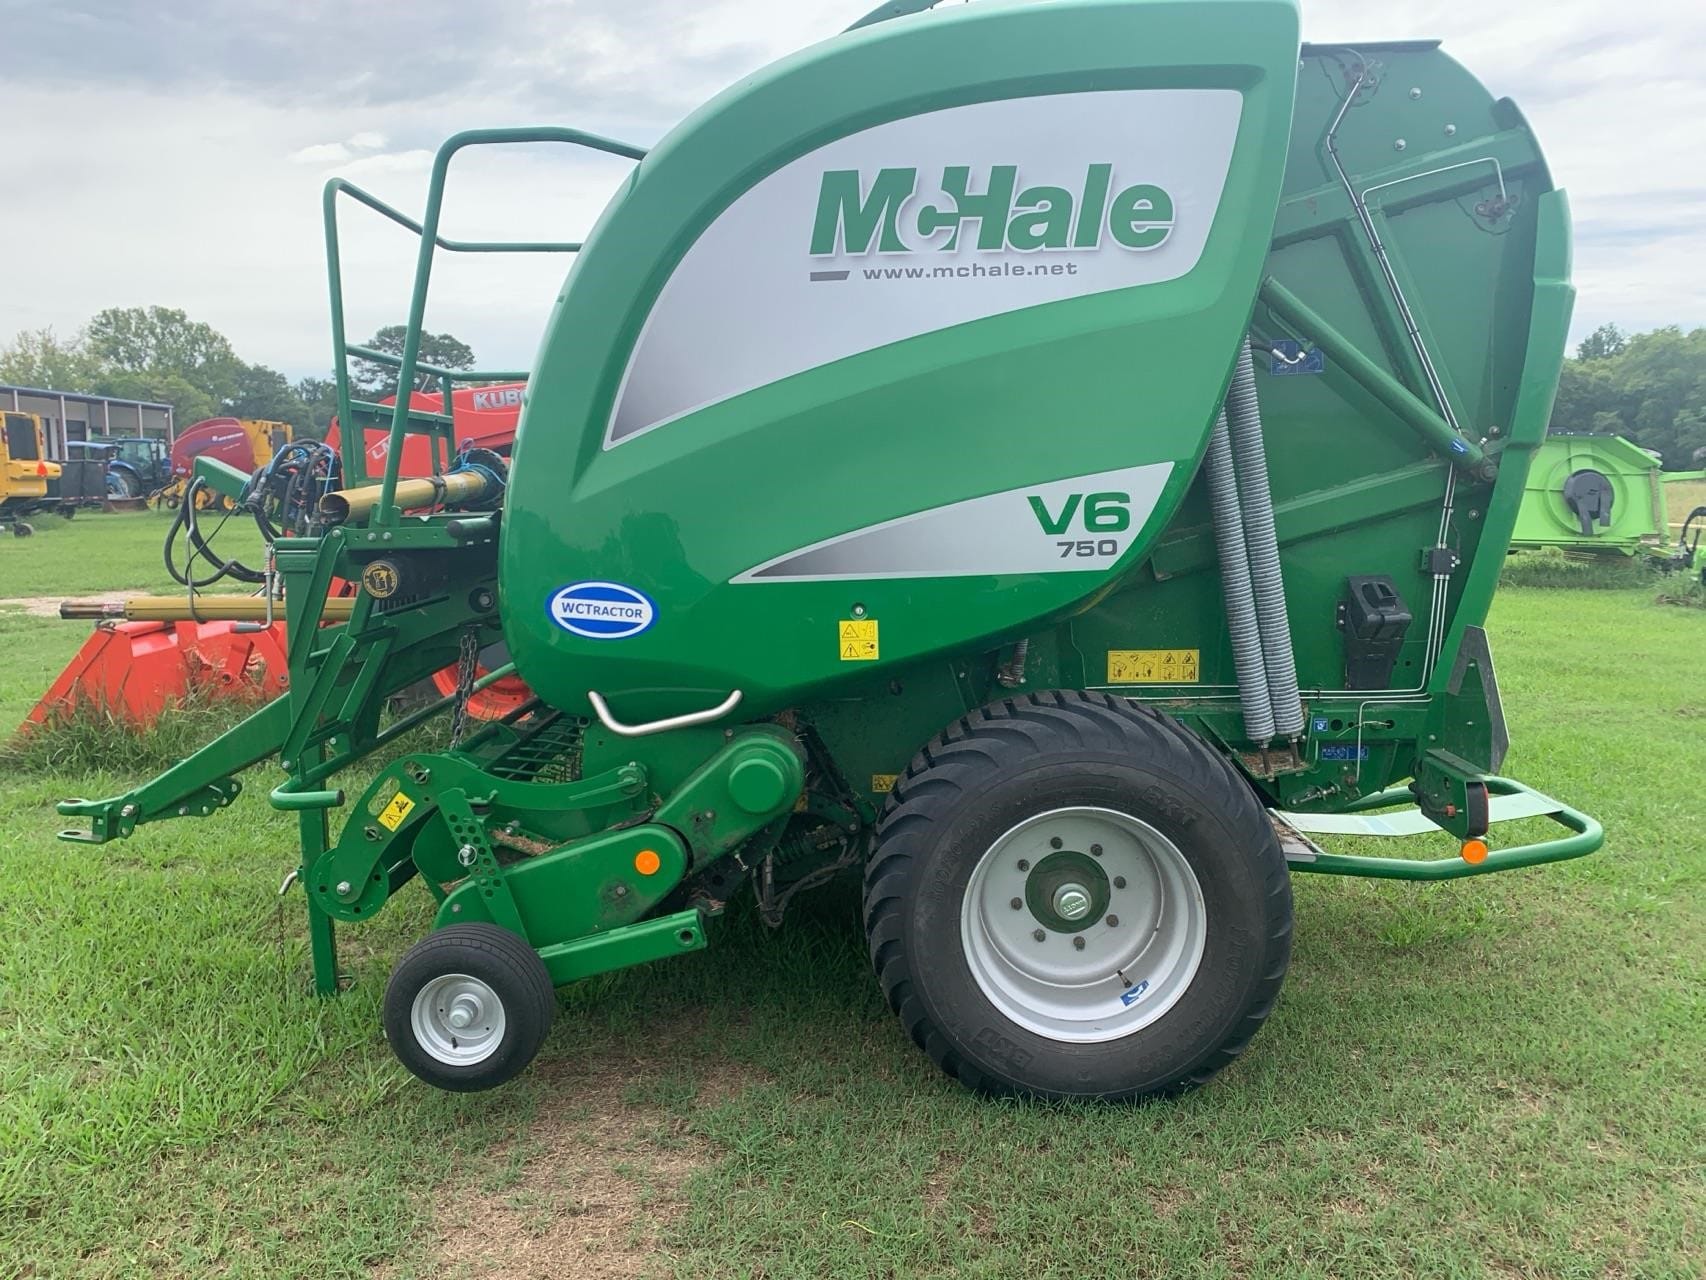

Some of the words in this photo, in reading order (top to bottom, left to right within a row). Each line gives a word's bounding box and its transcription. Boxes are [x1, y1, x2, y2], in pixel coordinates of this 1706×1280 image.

[808, 162, 1175, 255] McHale
[862, 261, 1079, 280] www.mchale.net
[1027, 491, 1131, 535] V6
[1056, 539, 1118, 558] 750
[561, 602, 643, 618] WCTRACTOR
